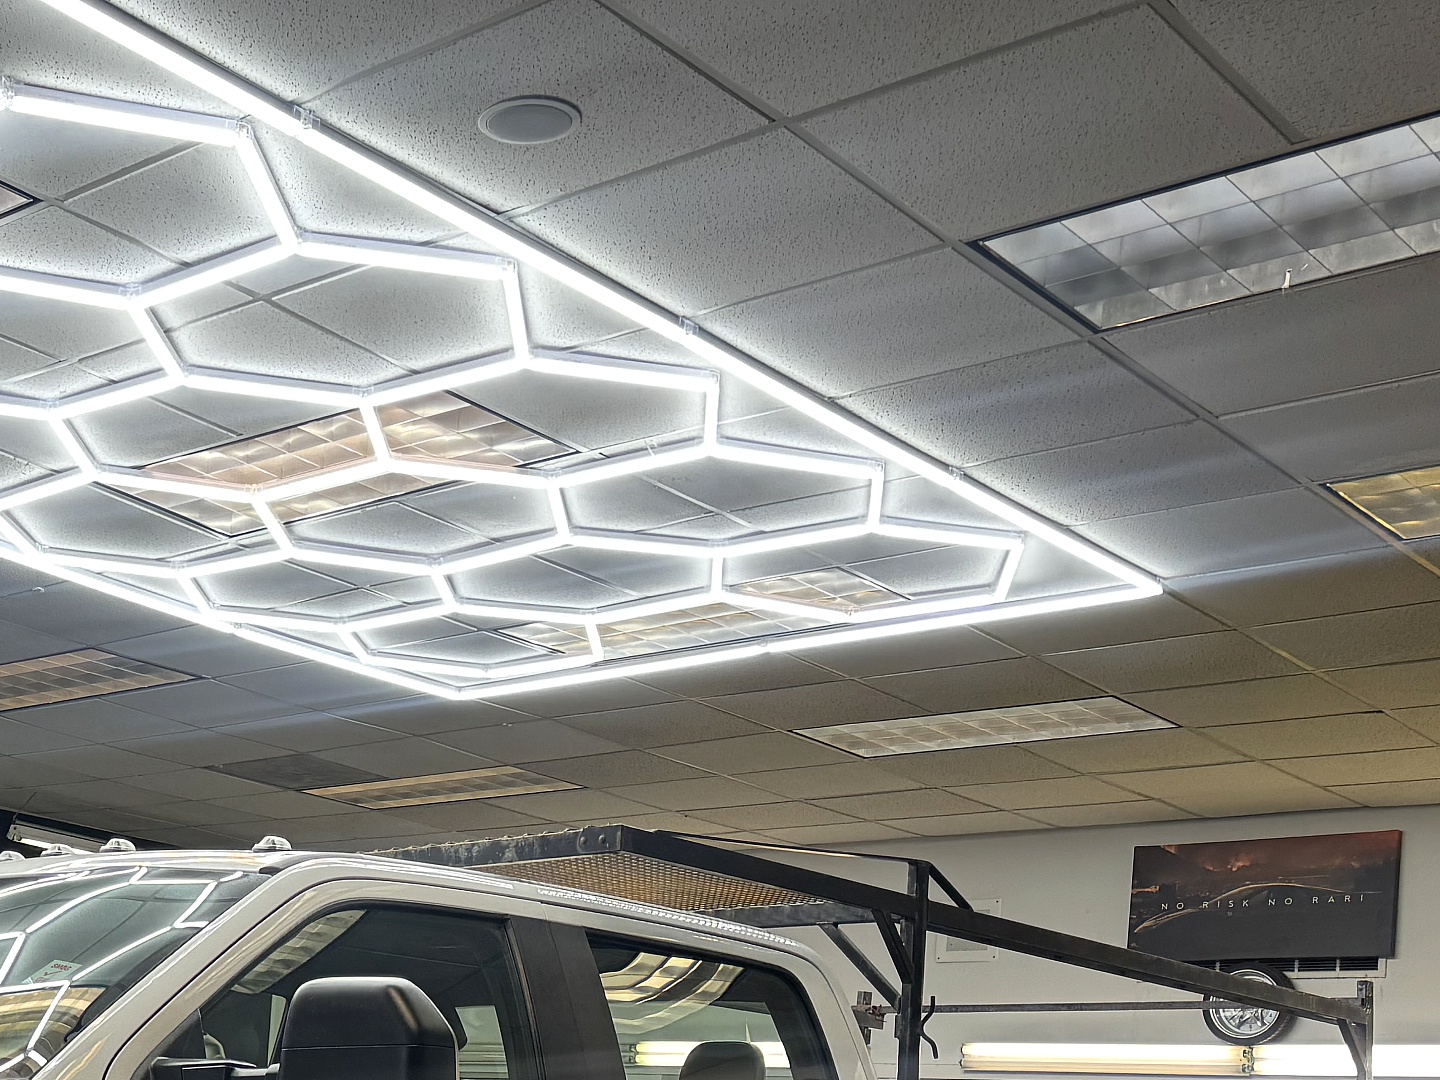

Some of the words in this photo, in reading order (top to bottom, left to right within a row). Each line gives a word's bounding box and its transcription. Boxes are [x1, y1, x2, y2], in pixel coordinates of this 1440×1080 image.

[1161, 902, 1184, 910] NO
[1202, 900, 1250, 909] RISK
[1268, 898, 1293, 906] NO
[1312, 894, 1364, 904] RARI
